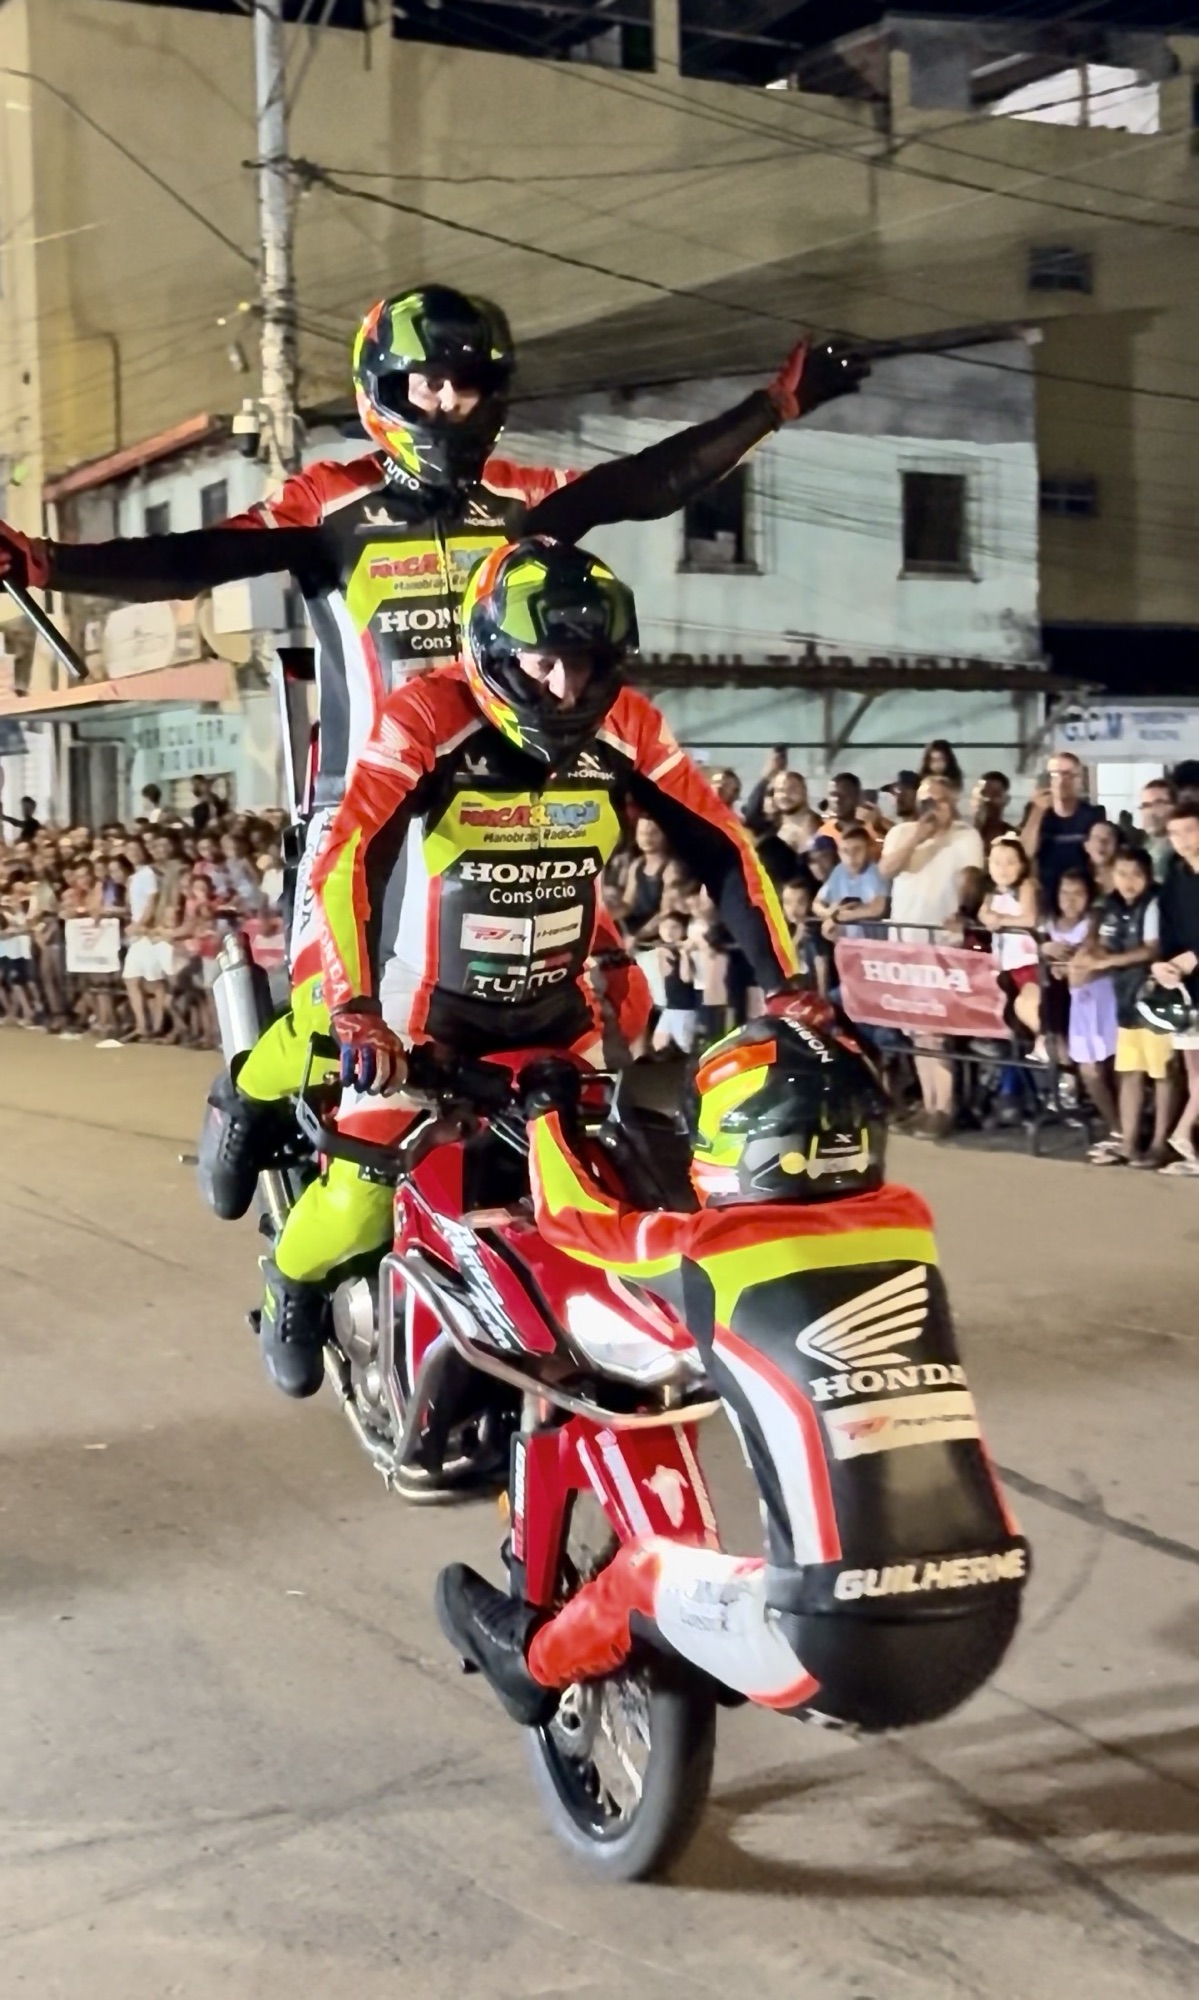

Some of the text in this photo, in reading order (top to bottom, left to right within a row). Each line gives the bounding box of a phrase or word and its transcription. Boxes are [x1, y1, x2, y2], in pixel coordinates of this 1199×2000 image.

[459, 857, 598, 884] HONDA
[489, 881, 576, 904] Consórcio
[861, 959, 974, 993] HONDA
